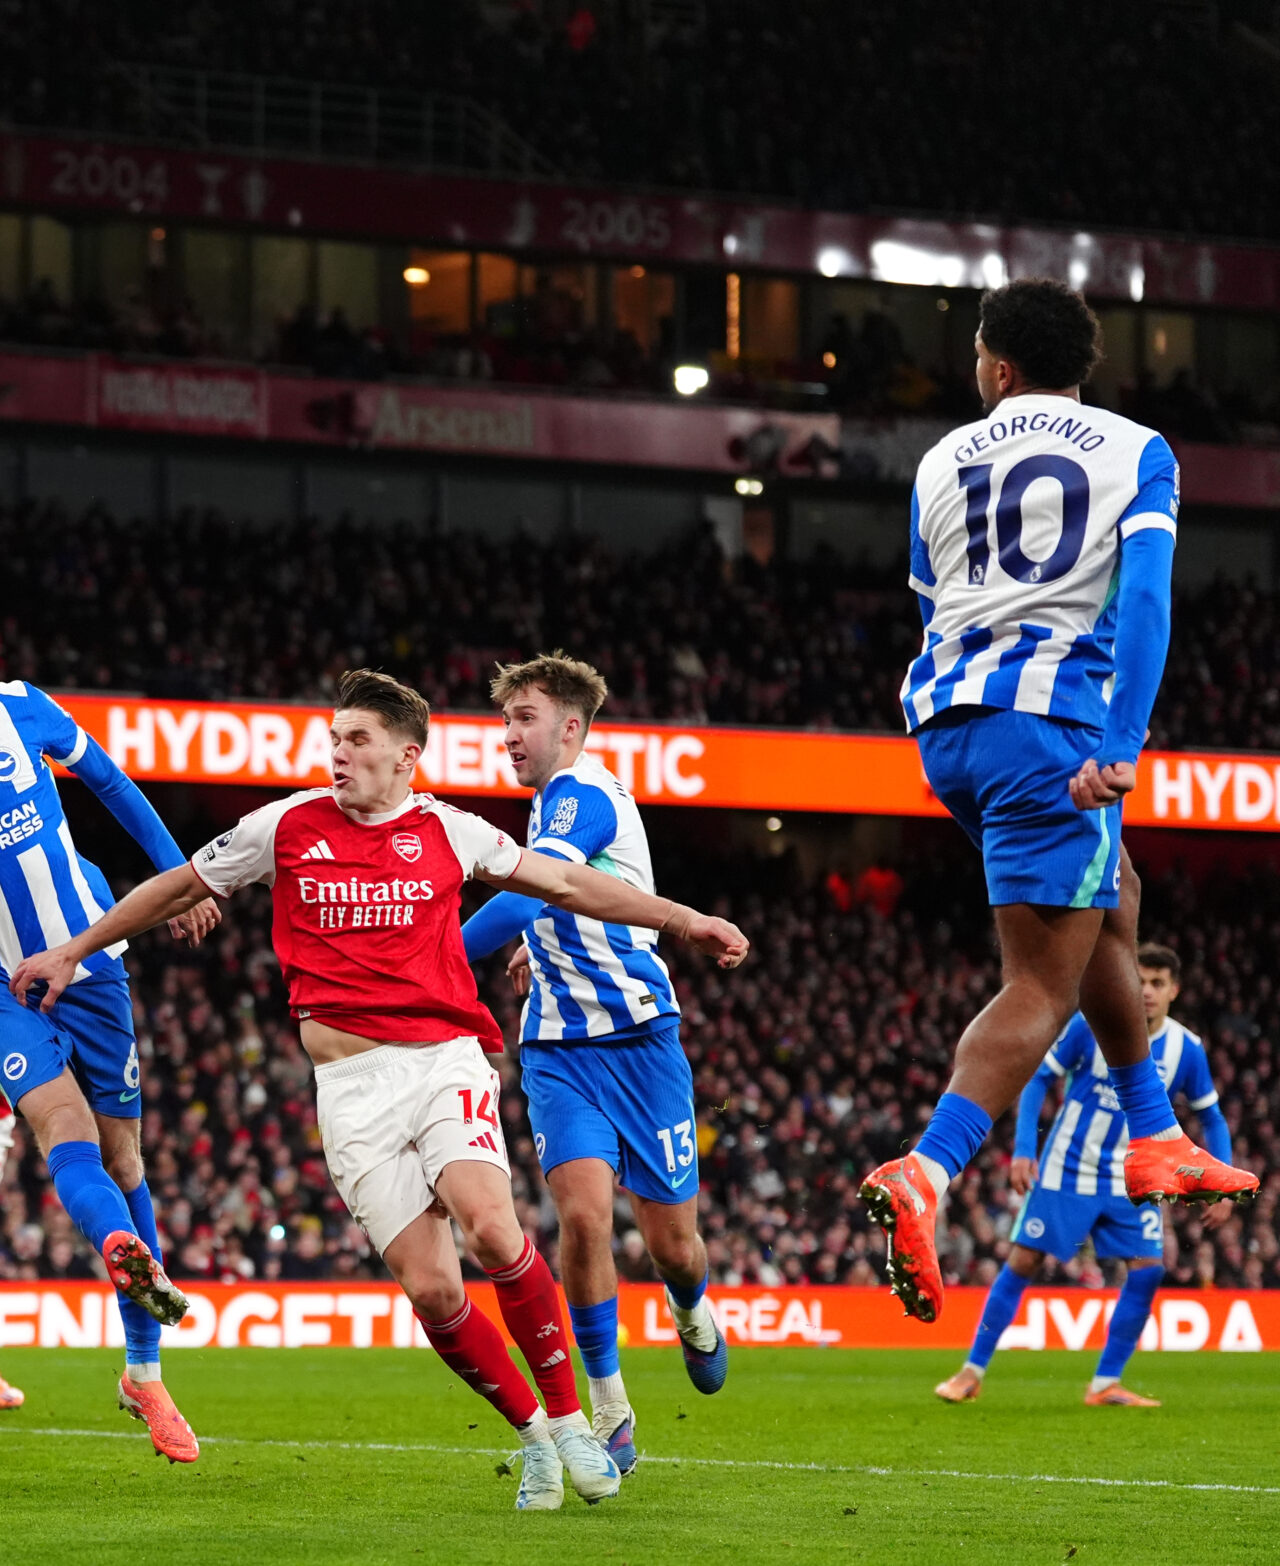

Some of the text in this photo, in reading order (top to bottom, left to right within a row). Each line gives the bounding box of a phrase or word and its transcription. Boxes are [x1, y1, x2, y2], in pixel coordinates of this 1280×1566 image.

[50, 150, 169, 200] 2004
[371, 388, 535, 450] Arsenal
[954, 412, 1105, 464] GEORGINIO
[957, 454, 1091, 586] 10
[1154, 758, 1280, 824] HYD
[298, 877, 434, 904] Emirates
[320, 905, 414, 928] FLY BETTER
[123, 1042, 140, 1089] 6
[458, 1088, 498, 1133] 14
[656, 1119, 696, 1174] 13
